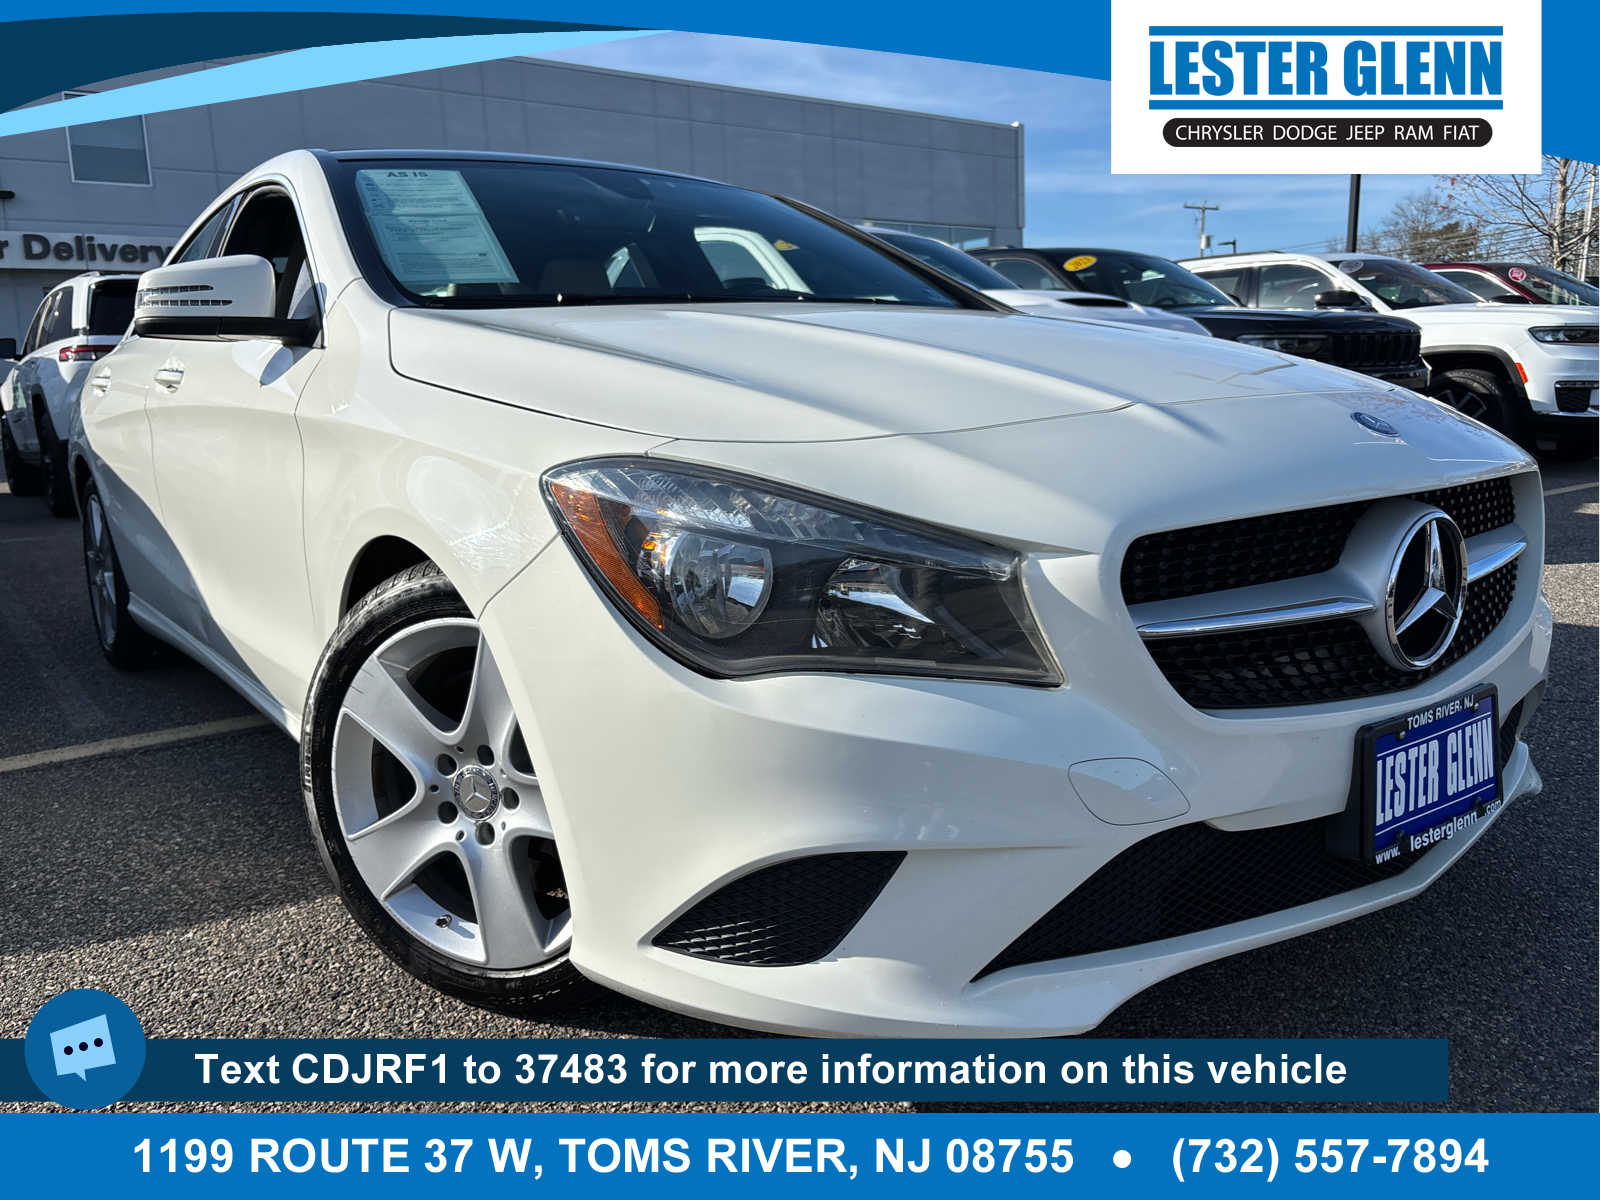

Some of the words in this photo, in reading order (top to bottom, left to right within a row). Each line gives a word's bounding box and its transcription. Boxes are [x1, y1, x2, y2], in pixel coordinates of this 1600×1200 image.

[1407, 711, 1433, 731] TOMS
[1464, 694, 1475, 709] NJ
[1375, 738, 1440, 827] LESTER
[1446, 717, 1495, 797] GLENN
[1375, 846, 1401, 865] www.
[1410, 811, 1479, 852] lesterglenn
